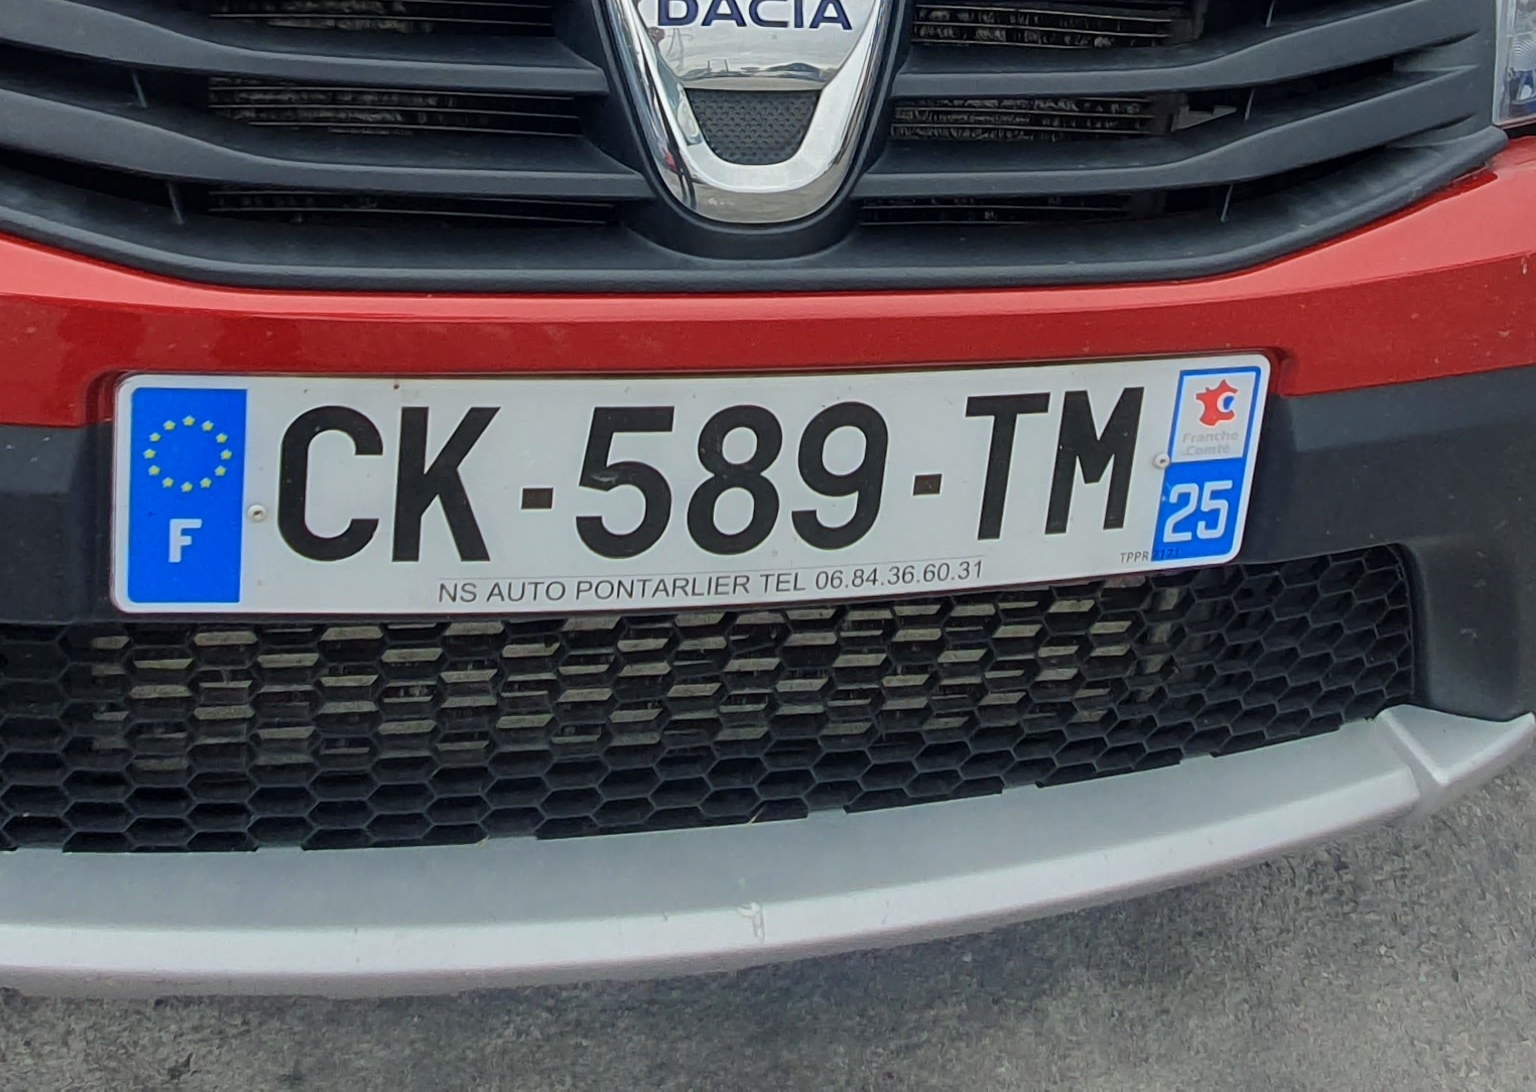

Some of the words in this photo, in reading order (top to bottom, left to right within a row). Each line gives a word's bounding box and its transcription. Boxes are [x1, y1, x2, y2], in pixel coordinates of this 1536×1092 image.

[1182, 430, 1240, 444] Franche
[277, 386, 1145, 562] CK-589-TM
[1163, 479, 1234, 543] 25
[168, 518, 203, 564] F
[438, 583, 478, 603] NS
[486, 580, 566, 603] AUTO
[575, 575, 751, 601] PONTARLIER
[760, 572, 807, 594] TEL
[815, 560, 983, 590] 06.84.36.60.31
